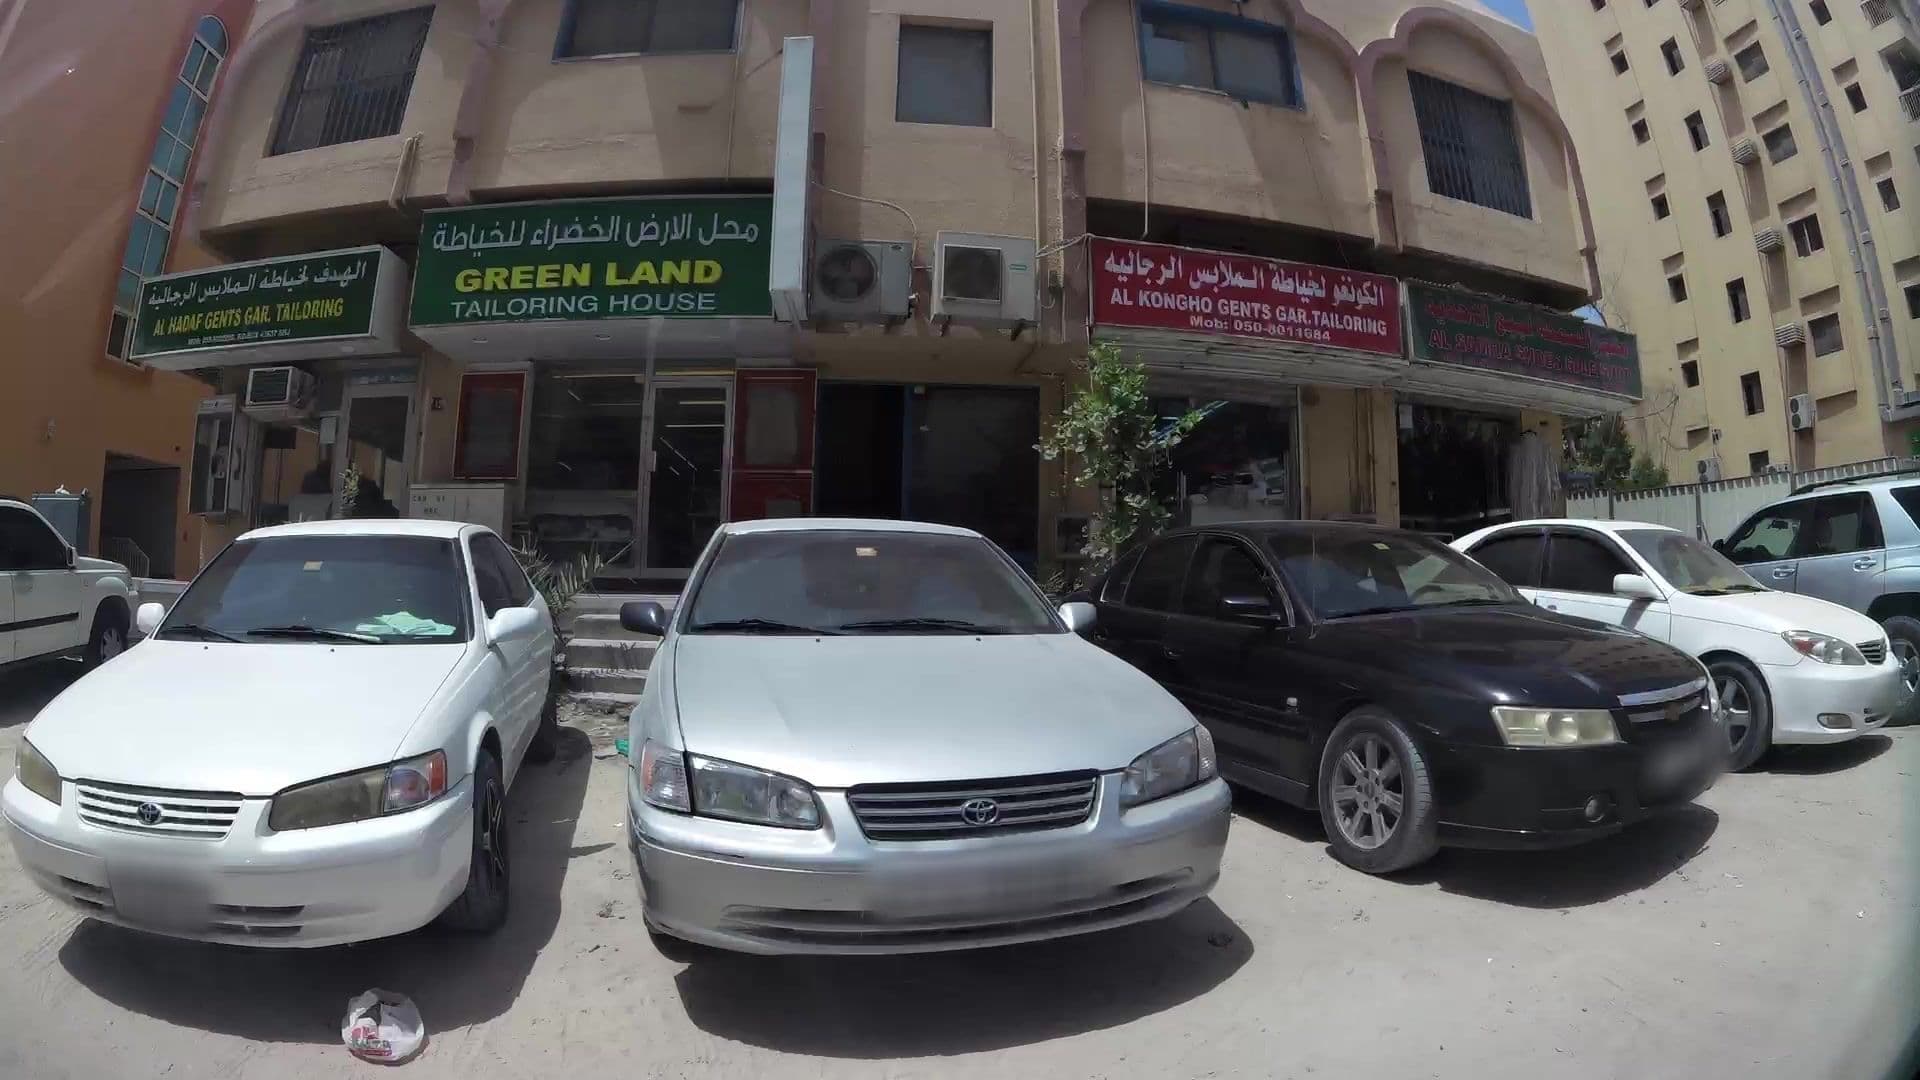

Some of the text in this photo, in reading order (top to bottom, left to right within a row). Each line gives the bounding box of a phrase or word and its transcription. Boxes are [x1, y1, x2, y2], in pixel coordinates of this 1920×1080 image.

[432, 219, 526, 257] للخياطة
[529, 215, 621, 251] الخضراء
[699, 213, 759, 247] محل
[197, 272, 256, 303] الملابس
[314, 260, 368, 288] الهدف
[454, 259, 723, 293] GREEN LAND
[1189, 259, 1264, 294] الملابس
[1270, 263, 1326, 304] لخياطة
[153, 318, 165, 336] AL
[167, 311, 202, 335] HADAF
[204, 307, 241, 330] GENTS
[276, 297, 344, 322] TAILORING
[451, 292, 716, 319] TAILORING HOUSE
[1110, 288, 1133, 306] AL
[1138, 290, 1213, 314] KONGHO
[1218, 299, 1272, 321] GENTS
[1190, 315, 1229, 330] Mob:
